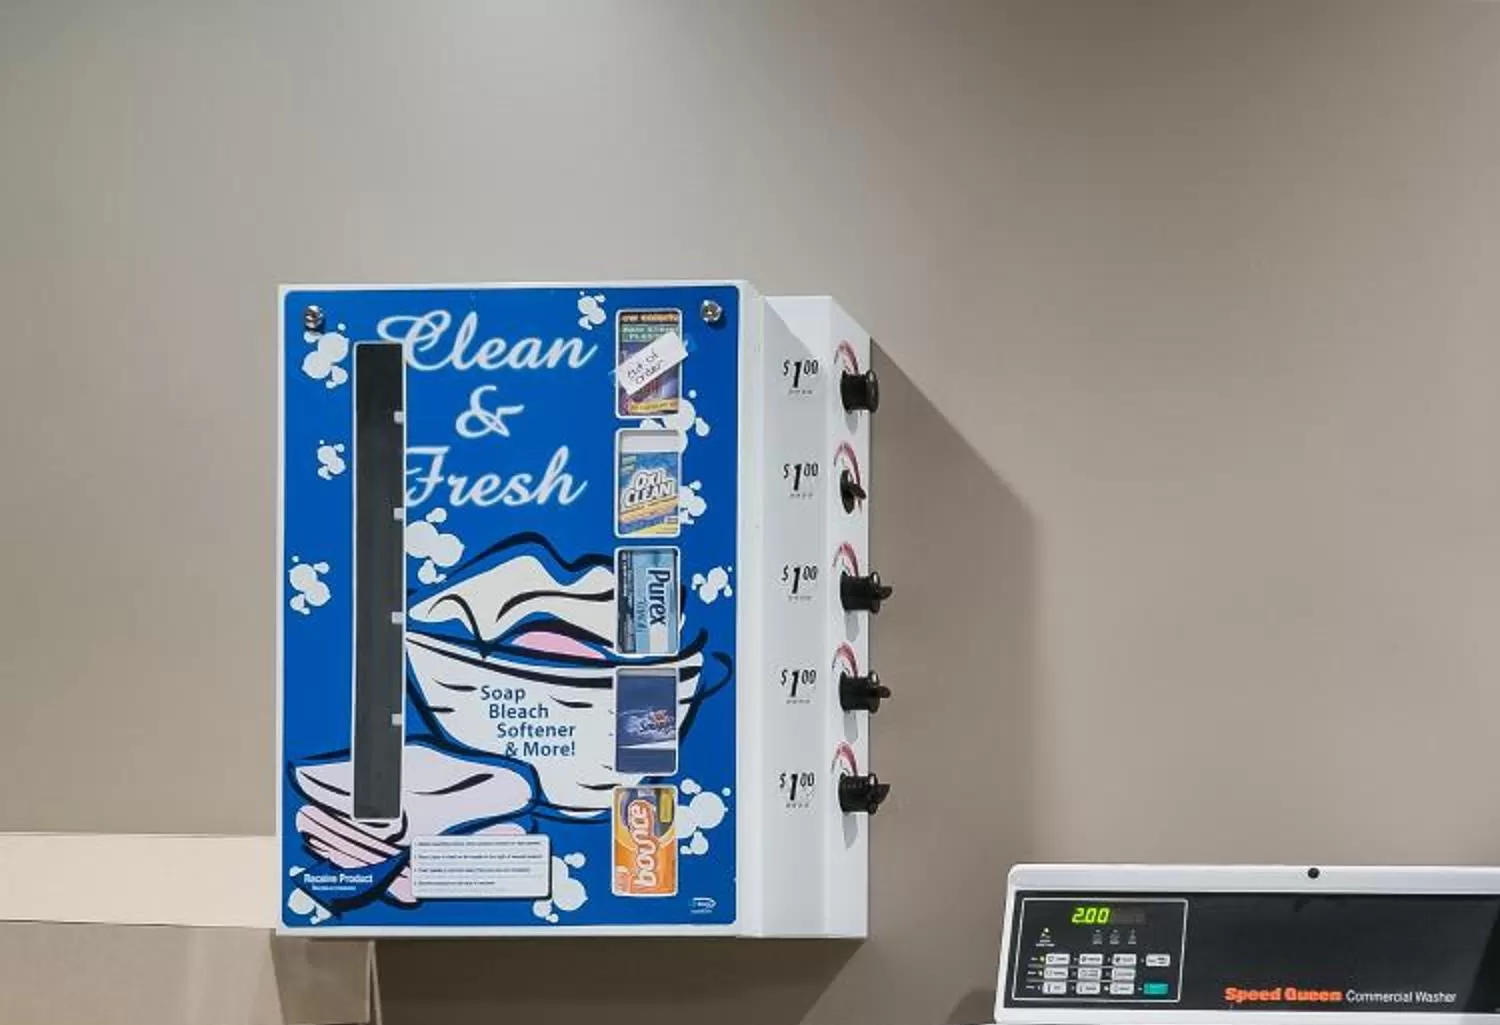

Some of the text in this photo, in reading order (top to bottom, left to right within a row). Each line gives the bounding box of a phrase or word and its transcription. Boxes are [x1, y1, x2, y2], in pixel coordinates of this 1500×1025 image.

[377, 310, 598, 371] Clean
[456, 385, 524, 438] &
[406, 446, 588, 507] Fresh
[648, 570, 671, 625] Purex
[481, 685, 526, 704] Soap
[489, 704, 549, 719] Bleach
[497, 722, 576, 738] Softener
[505, 741, 575, 757] & More!
[340, 874, 373, 883] Product
[1224, 987, 1457, 1003] Speed Queen Commercial Washer
